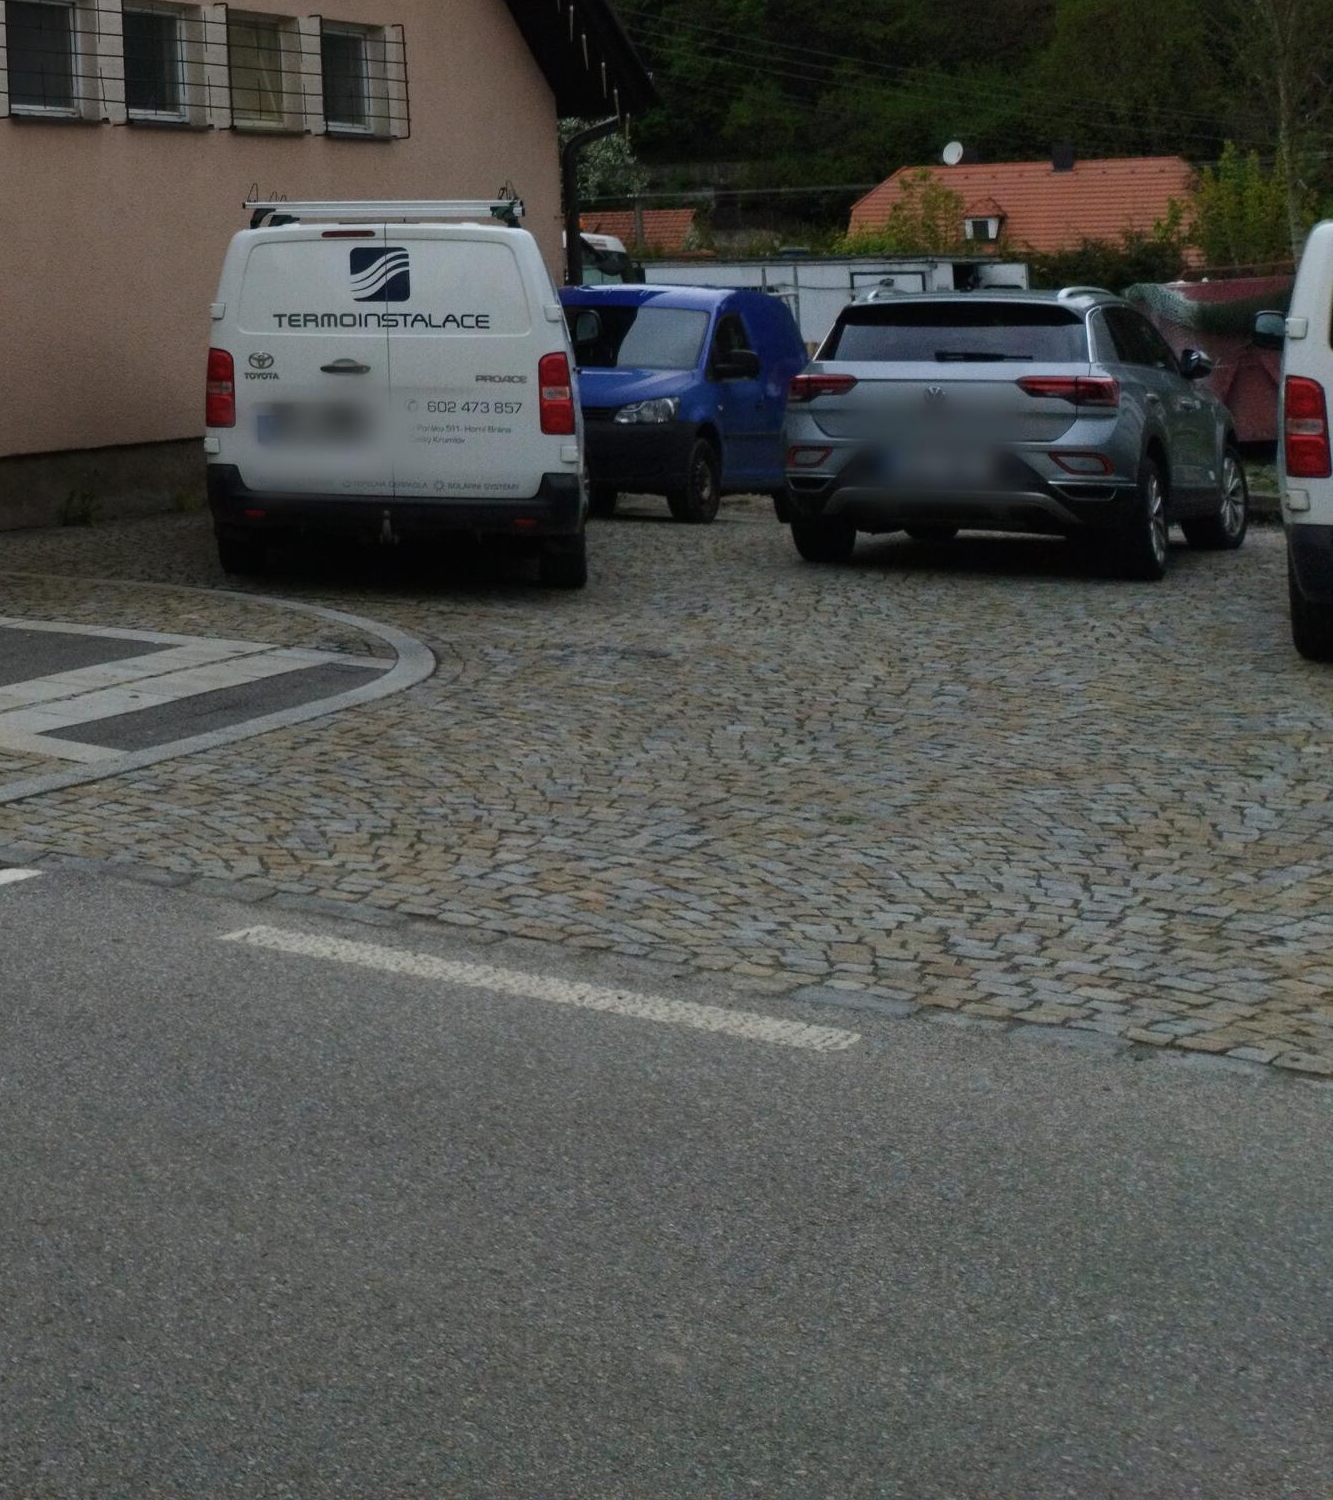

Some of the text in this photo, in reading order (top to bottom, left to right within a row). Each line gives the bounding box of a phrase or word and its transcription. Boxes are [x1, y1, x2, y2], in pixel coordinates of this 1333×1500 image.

[273, 313, 490, 329] TERMOINSTALACE
[244, 372, 280, 381] TOYOTA
[475, 375, 528, 384] PROACE
[427, 401, 523, 414] 602 473 857
